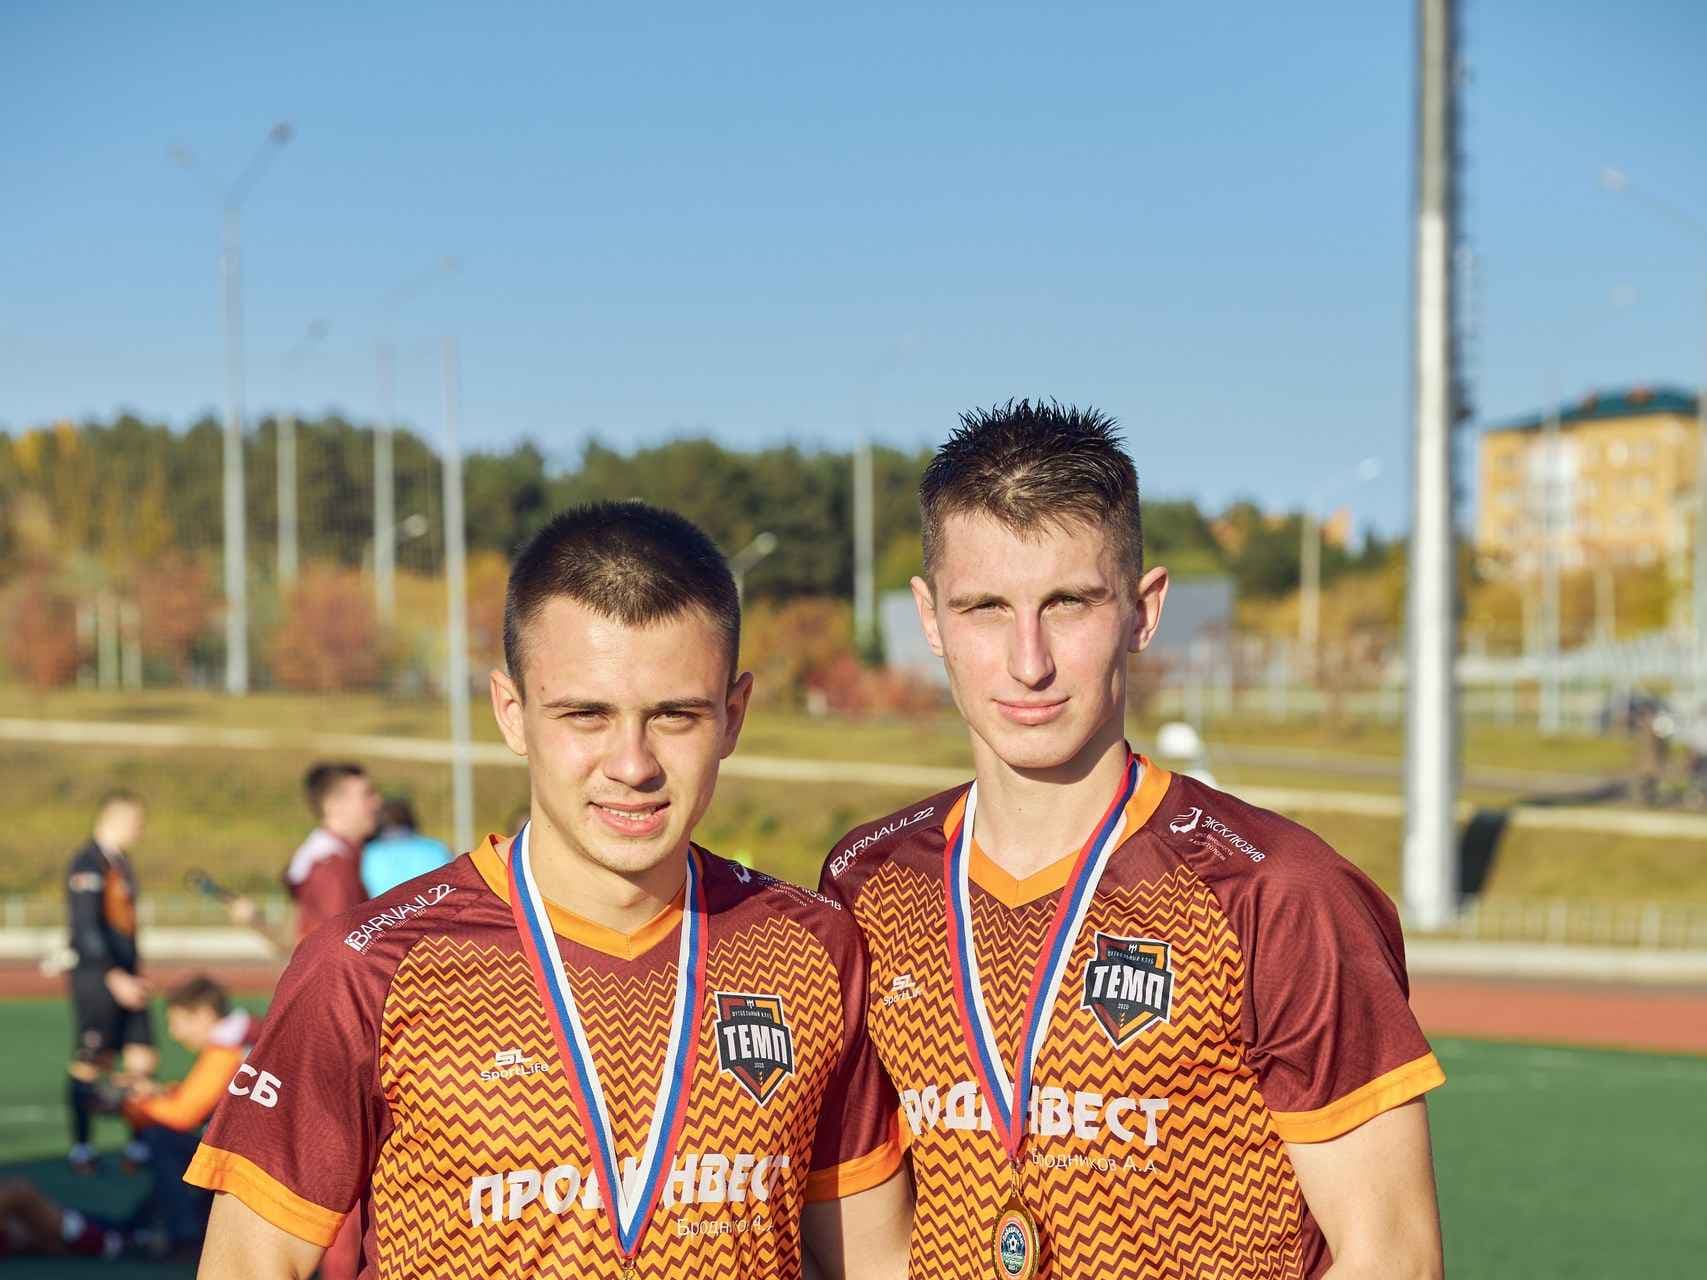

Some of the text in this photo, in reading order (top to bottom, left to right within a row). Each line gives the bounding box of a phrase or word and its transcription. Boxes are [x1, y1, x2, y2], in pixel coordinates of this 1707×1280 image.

[1201, 816, 1266, 863] ЭКСКЛЮЗИВ
[1091, 965, 1165, 1010] ТЕМП
[723, 1024, 788, 1065] ТЕМП
